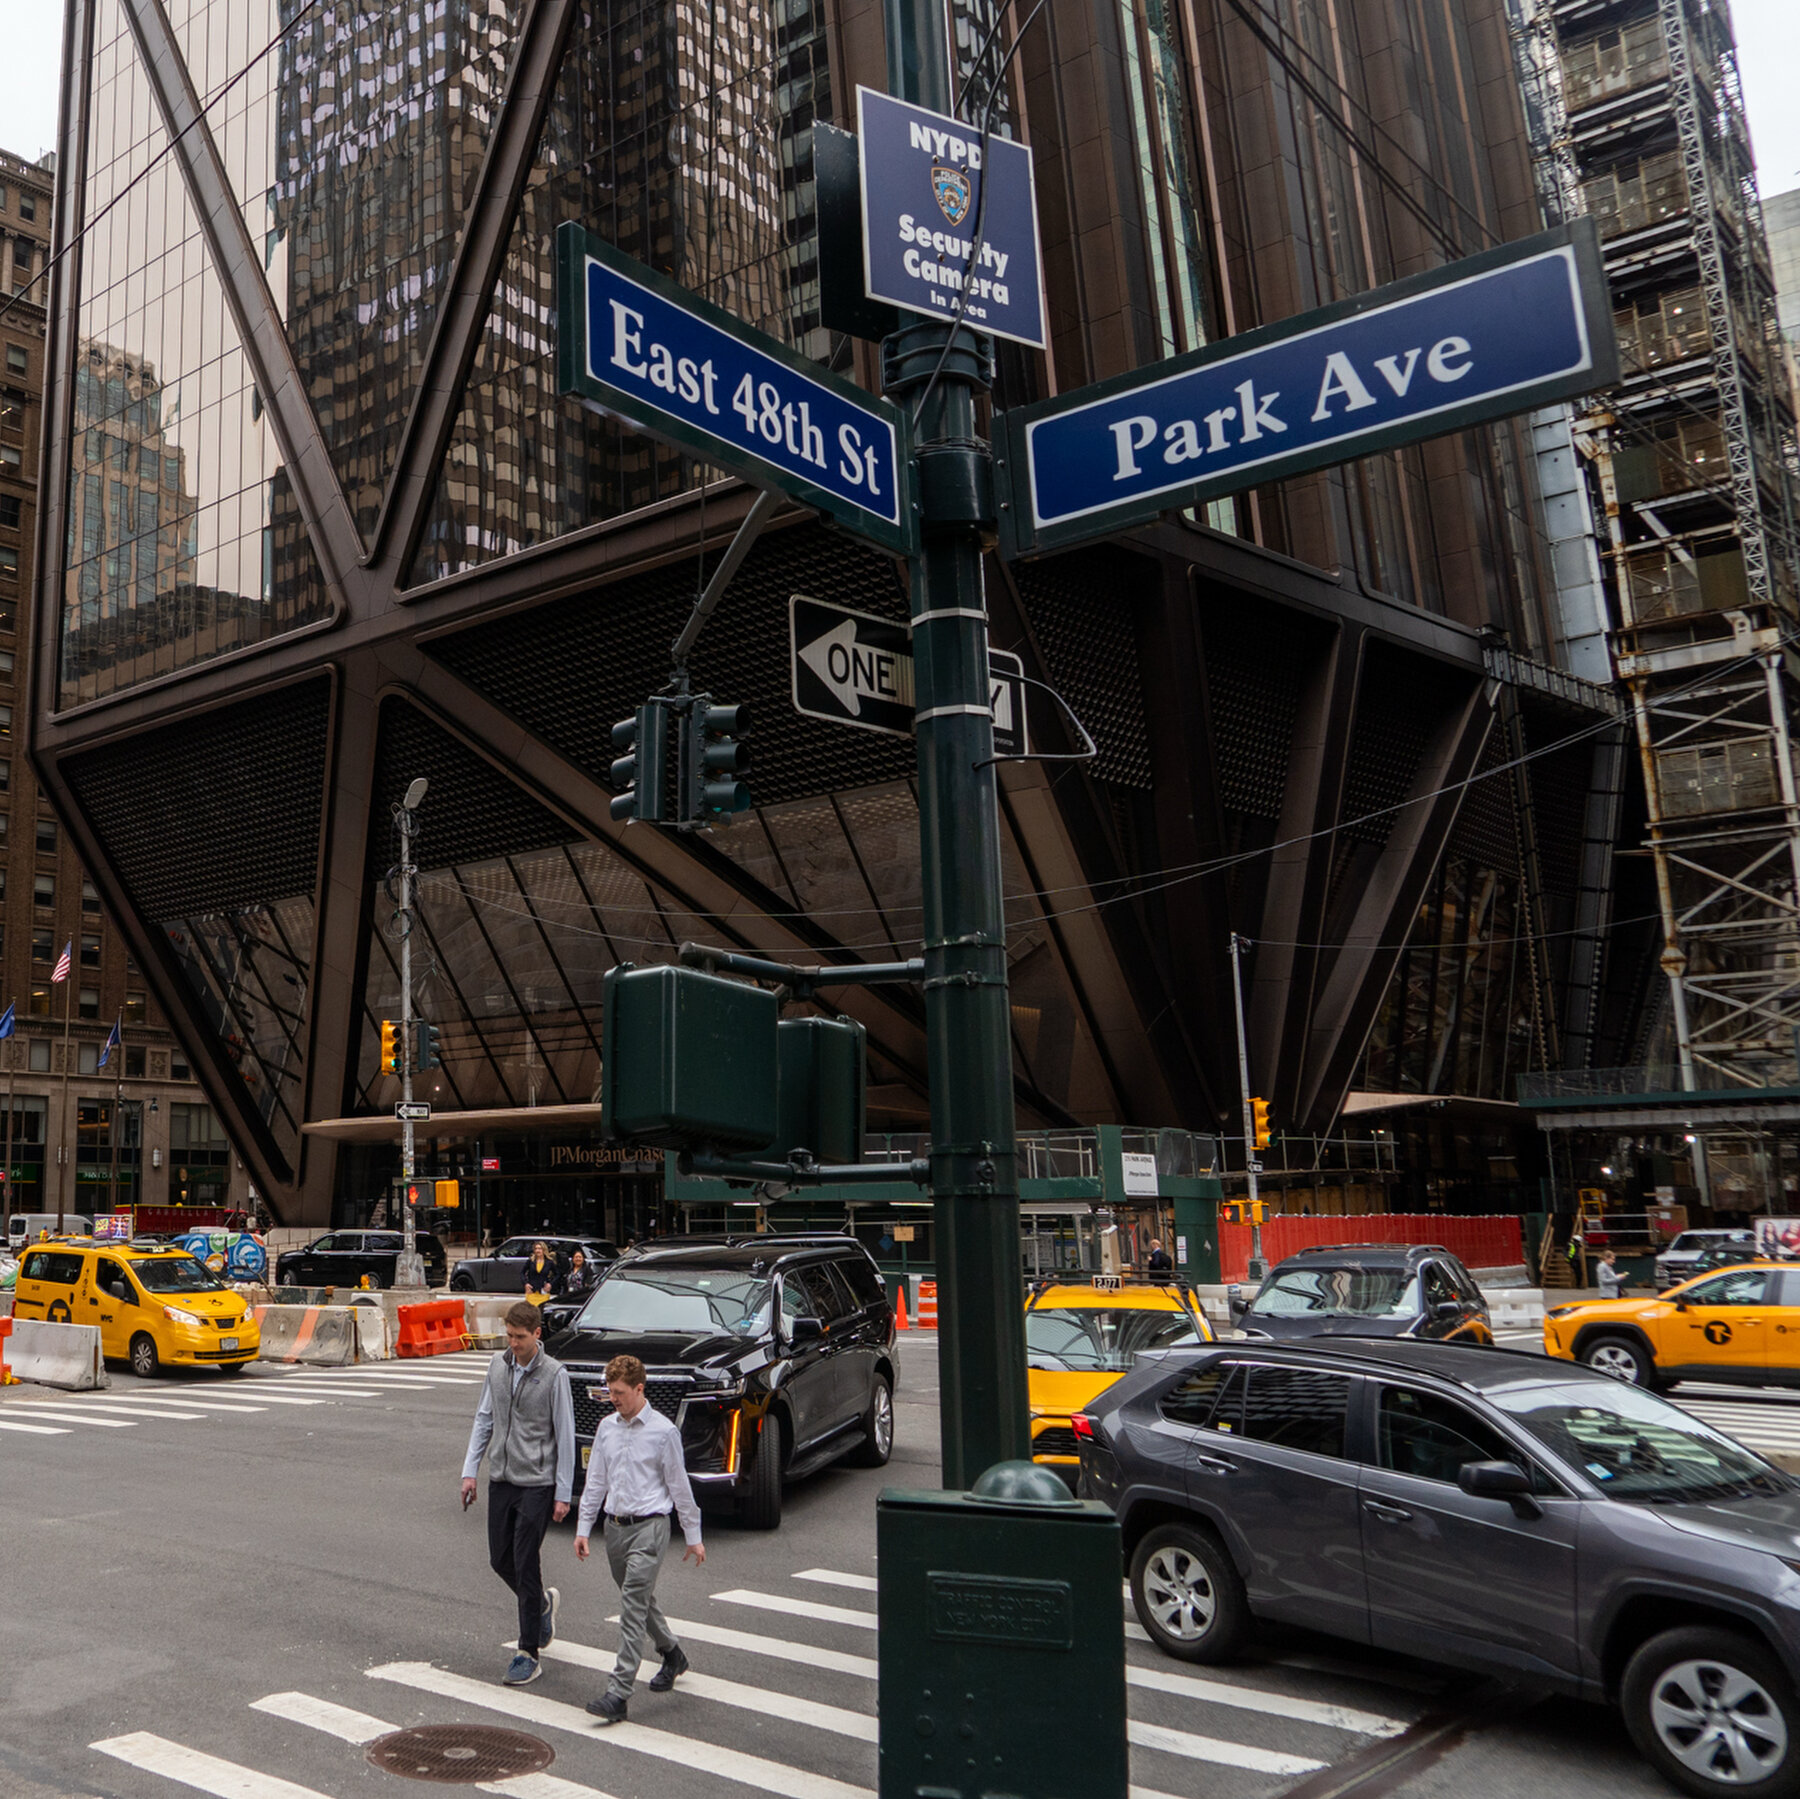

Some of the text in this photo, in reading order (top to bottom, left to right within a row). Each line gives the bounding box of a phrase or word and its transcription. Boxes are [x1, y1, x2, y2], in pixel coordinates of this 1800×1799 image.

[911, 121, 983, 170] NYPD
[903, 249, 1009, 306] Camera
[931, 289, 946, 307] In
[609, 298, 881, 496] East 48th St
[1108, 336, 1474, 481] Park Ave
[828, 642, 897, 697] ONE
